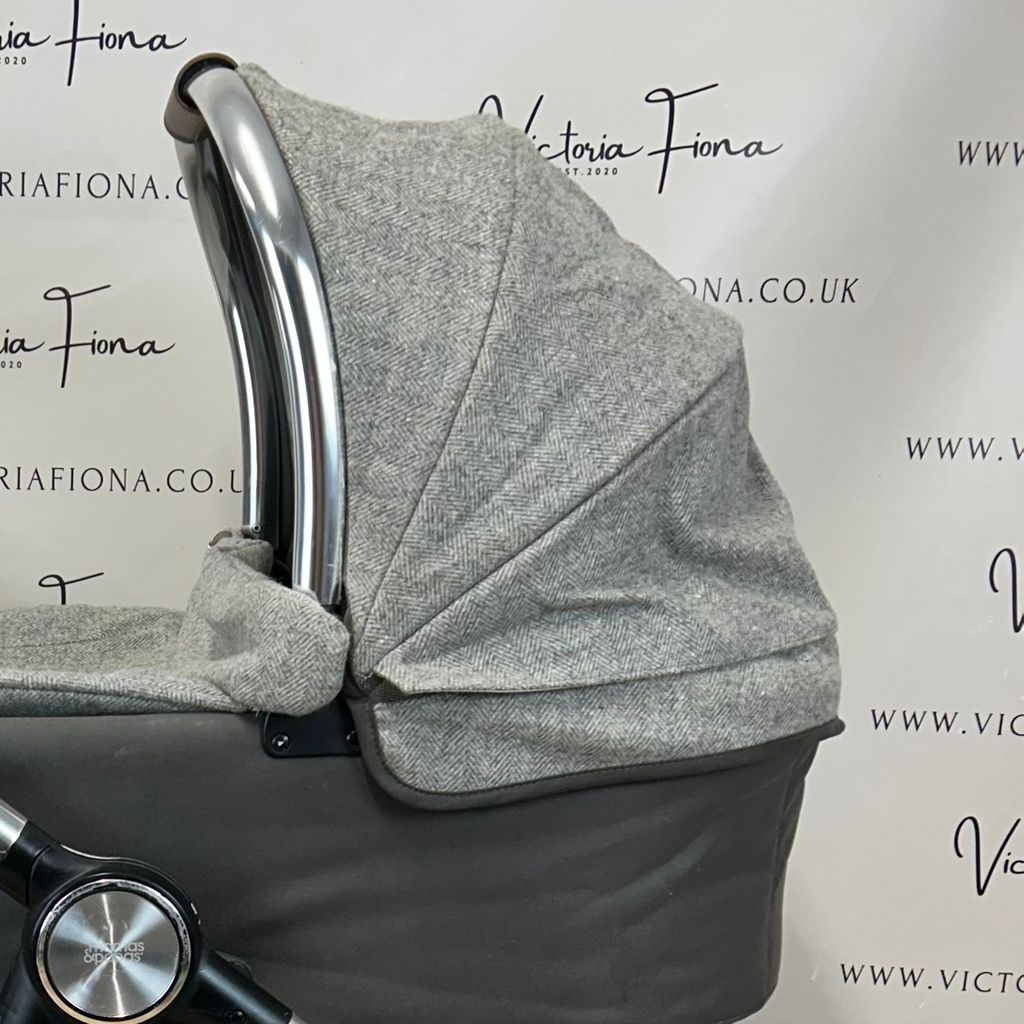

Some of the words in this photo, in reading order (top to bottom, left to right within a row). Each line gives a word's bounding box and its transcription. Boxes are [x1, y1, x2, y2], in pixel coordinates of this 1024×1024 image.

[565, 167, 618, 176] ST.2020
[644, 83, 784, 194] Fiona
[43, 284, 176, 388] Fiona
